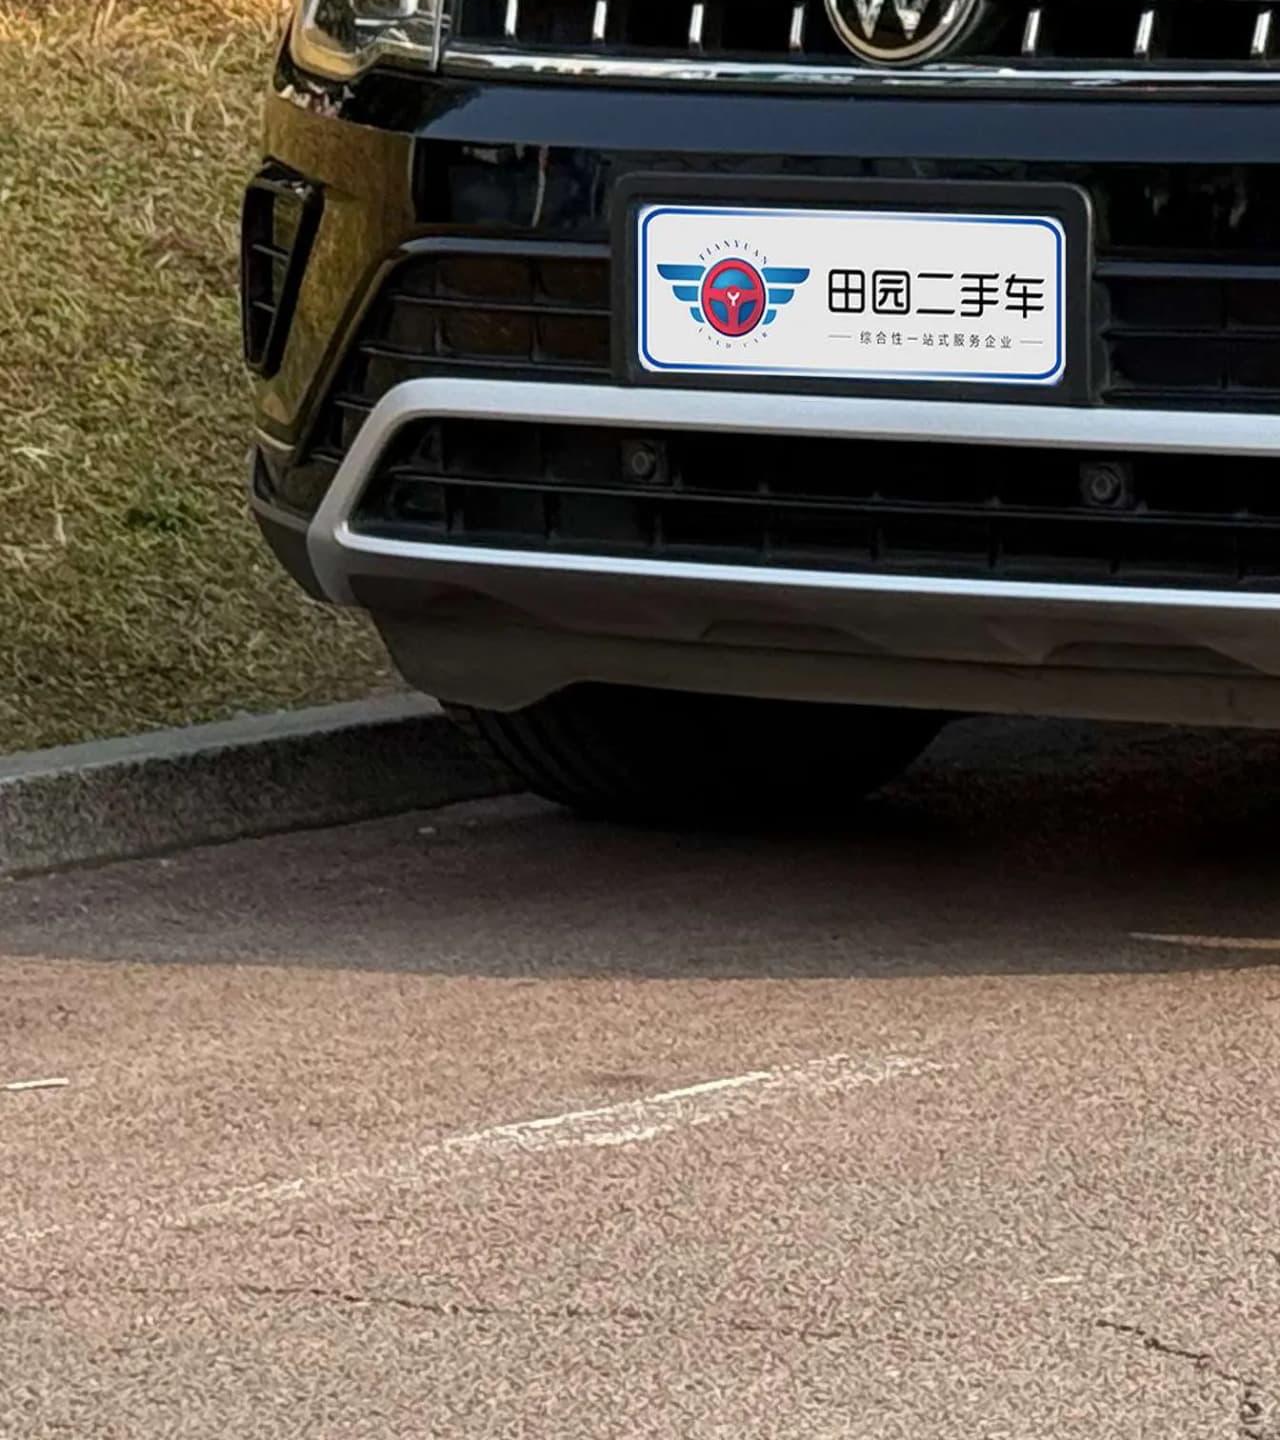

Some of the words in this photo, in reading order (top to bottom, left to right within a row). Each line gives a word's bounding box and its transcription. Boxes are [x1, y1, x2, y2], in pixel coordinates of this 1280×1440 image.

[828, 268, 1045, 319] 田园二手车
[859, 330, 1012, 349] 综合性一站式服务企业
